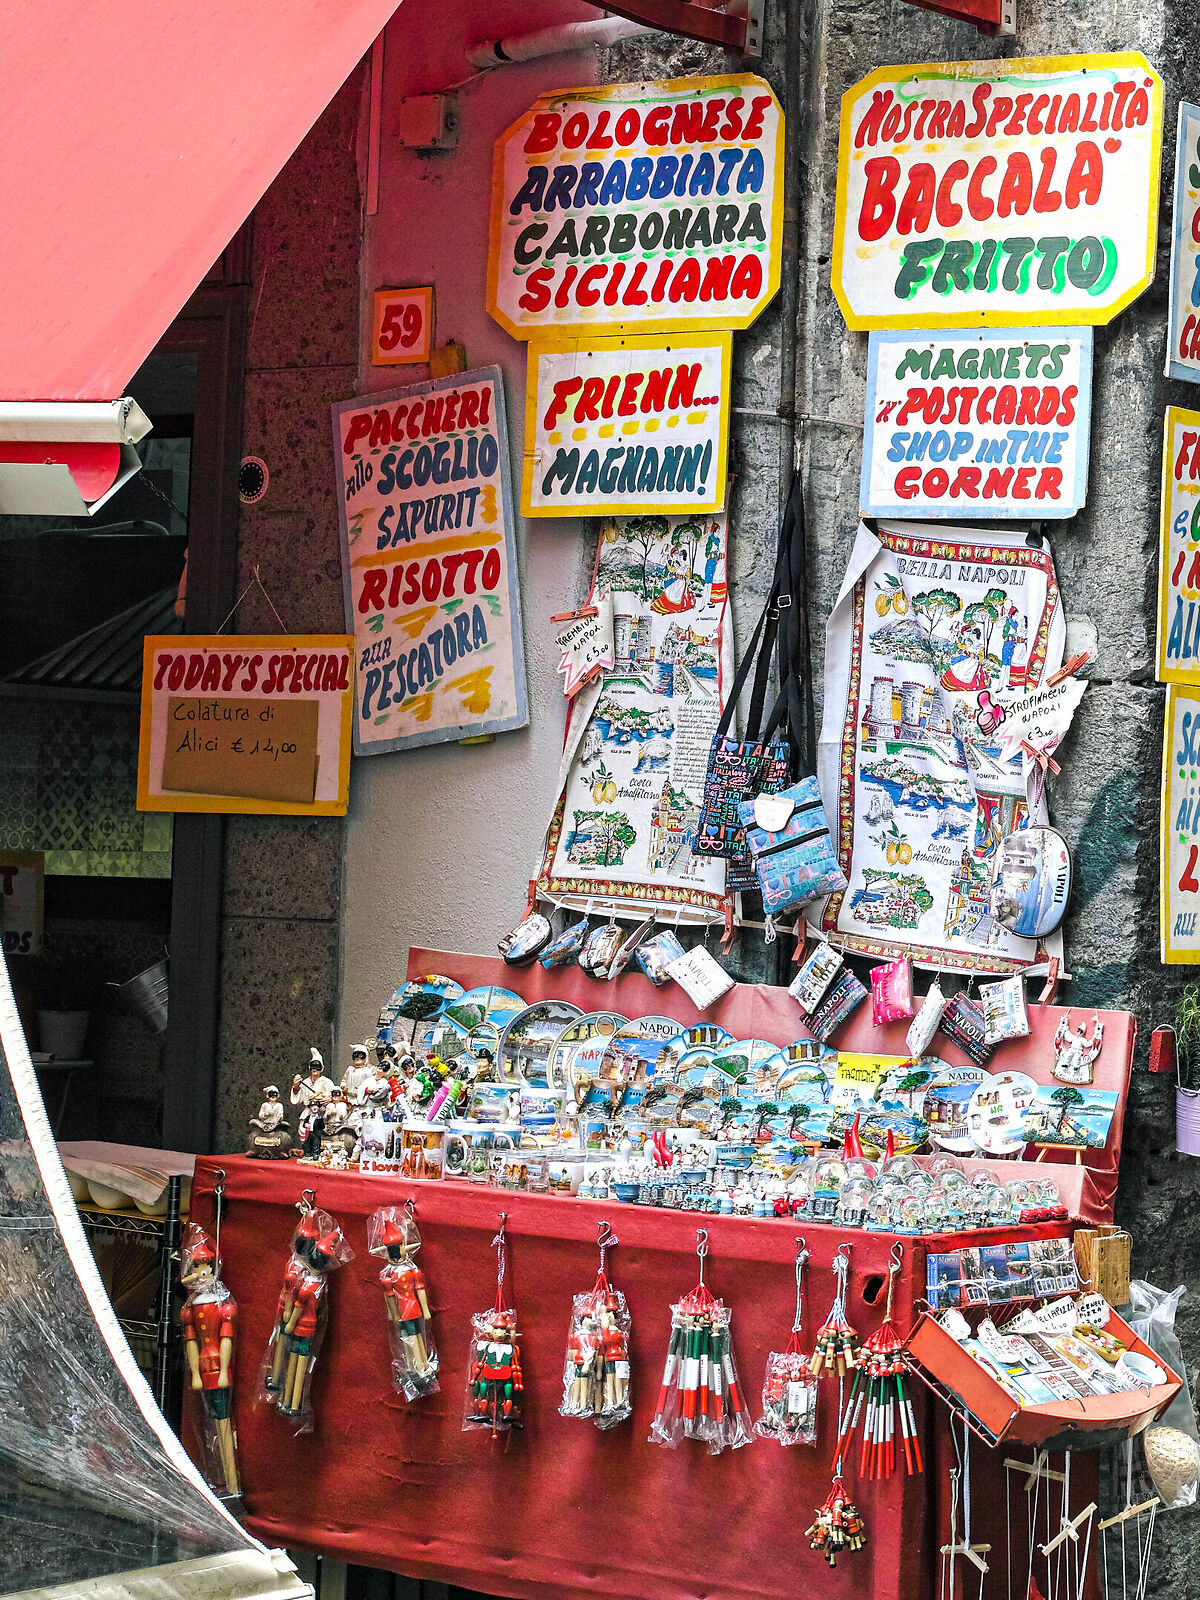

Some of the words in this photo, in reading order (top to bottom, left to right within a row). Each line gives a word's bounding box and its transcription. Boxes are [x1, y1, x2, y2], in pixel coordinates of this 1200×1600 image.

[524, 96, 772, 154] BOLOGNESE
[854, 89, 966, 149] NOSTRA
[509, 148, 764, 215] ARRABBIATA
[514, 203, 766, 265] CARBONARA
[518, 254, 763, 312] SICILIANA
[894, 235, 1105, 299] FRITTO
[378, 303, 423, 350] 59
[895, 344, 1071, 380] MAGNETS
[343, 387, 491, 455] PACCHERI
[896, 384, 1078, 427] POSTCARDS
[886, 430, 974, 463] SHOP
[1006, 430, 1069, 464] THE
[376, 433, 499, 496] SCOGLIO
[542, 438, 713, 495] MAGNANN!
[894, 466, 1063, 499] CORNER
[377, 486, 481, 550] SAPURIT
[357, 547, 501, 614] RISOTTO
[897, 558, 952, 580] BELLA
[958, 565, 1026, 586] NAPOLI
[1172, 551, 1185, 587] I
[153, 653, 263, 692] TODAY'S
[261, 653, 349, 694] SPECIAL
[361, 604, 488, 720] PESCATORA
[586, 653, 593, 663] €
[174, 699, 250, 721] Colatura
[259, 705, 275, 721] di
[1003, 684, 1067, 718] STROFINACCIO
[176, 728, 218, 752] Alici
[231, 737, 245, 752] €
[976, 772, 999, 781] POMPEI
[928, 842, 951, 853] Costa
[1174, 913, 1198, 938] ALLE
[688, 960, 712, 986] NAPOLI
[817, 986, 848, 1019] NAPOLI
[639, 1022, 680, 1036] NAPOLI
[952, 1012, 985, 1043] NAPOLI
[842, 1088, 860, 1098] STA
[948, 1071, 984, 1081] NAPOLI
[362, 1160, 370, 1171] I
[372, 1160, 399, 1172] love
[938, 1256, 958, 1265] NAPOLI
[984, 1248, 1006, 1257] NAPOLI
